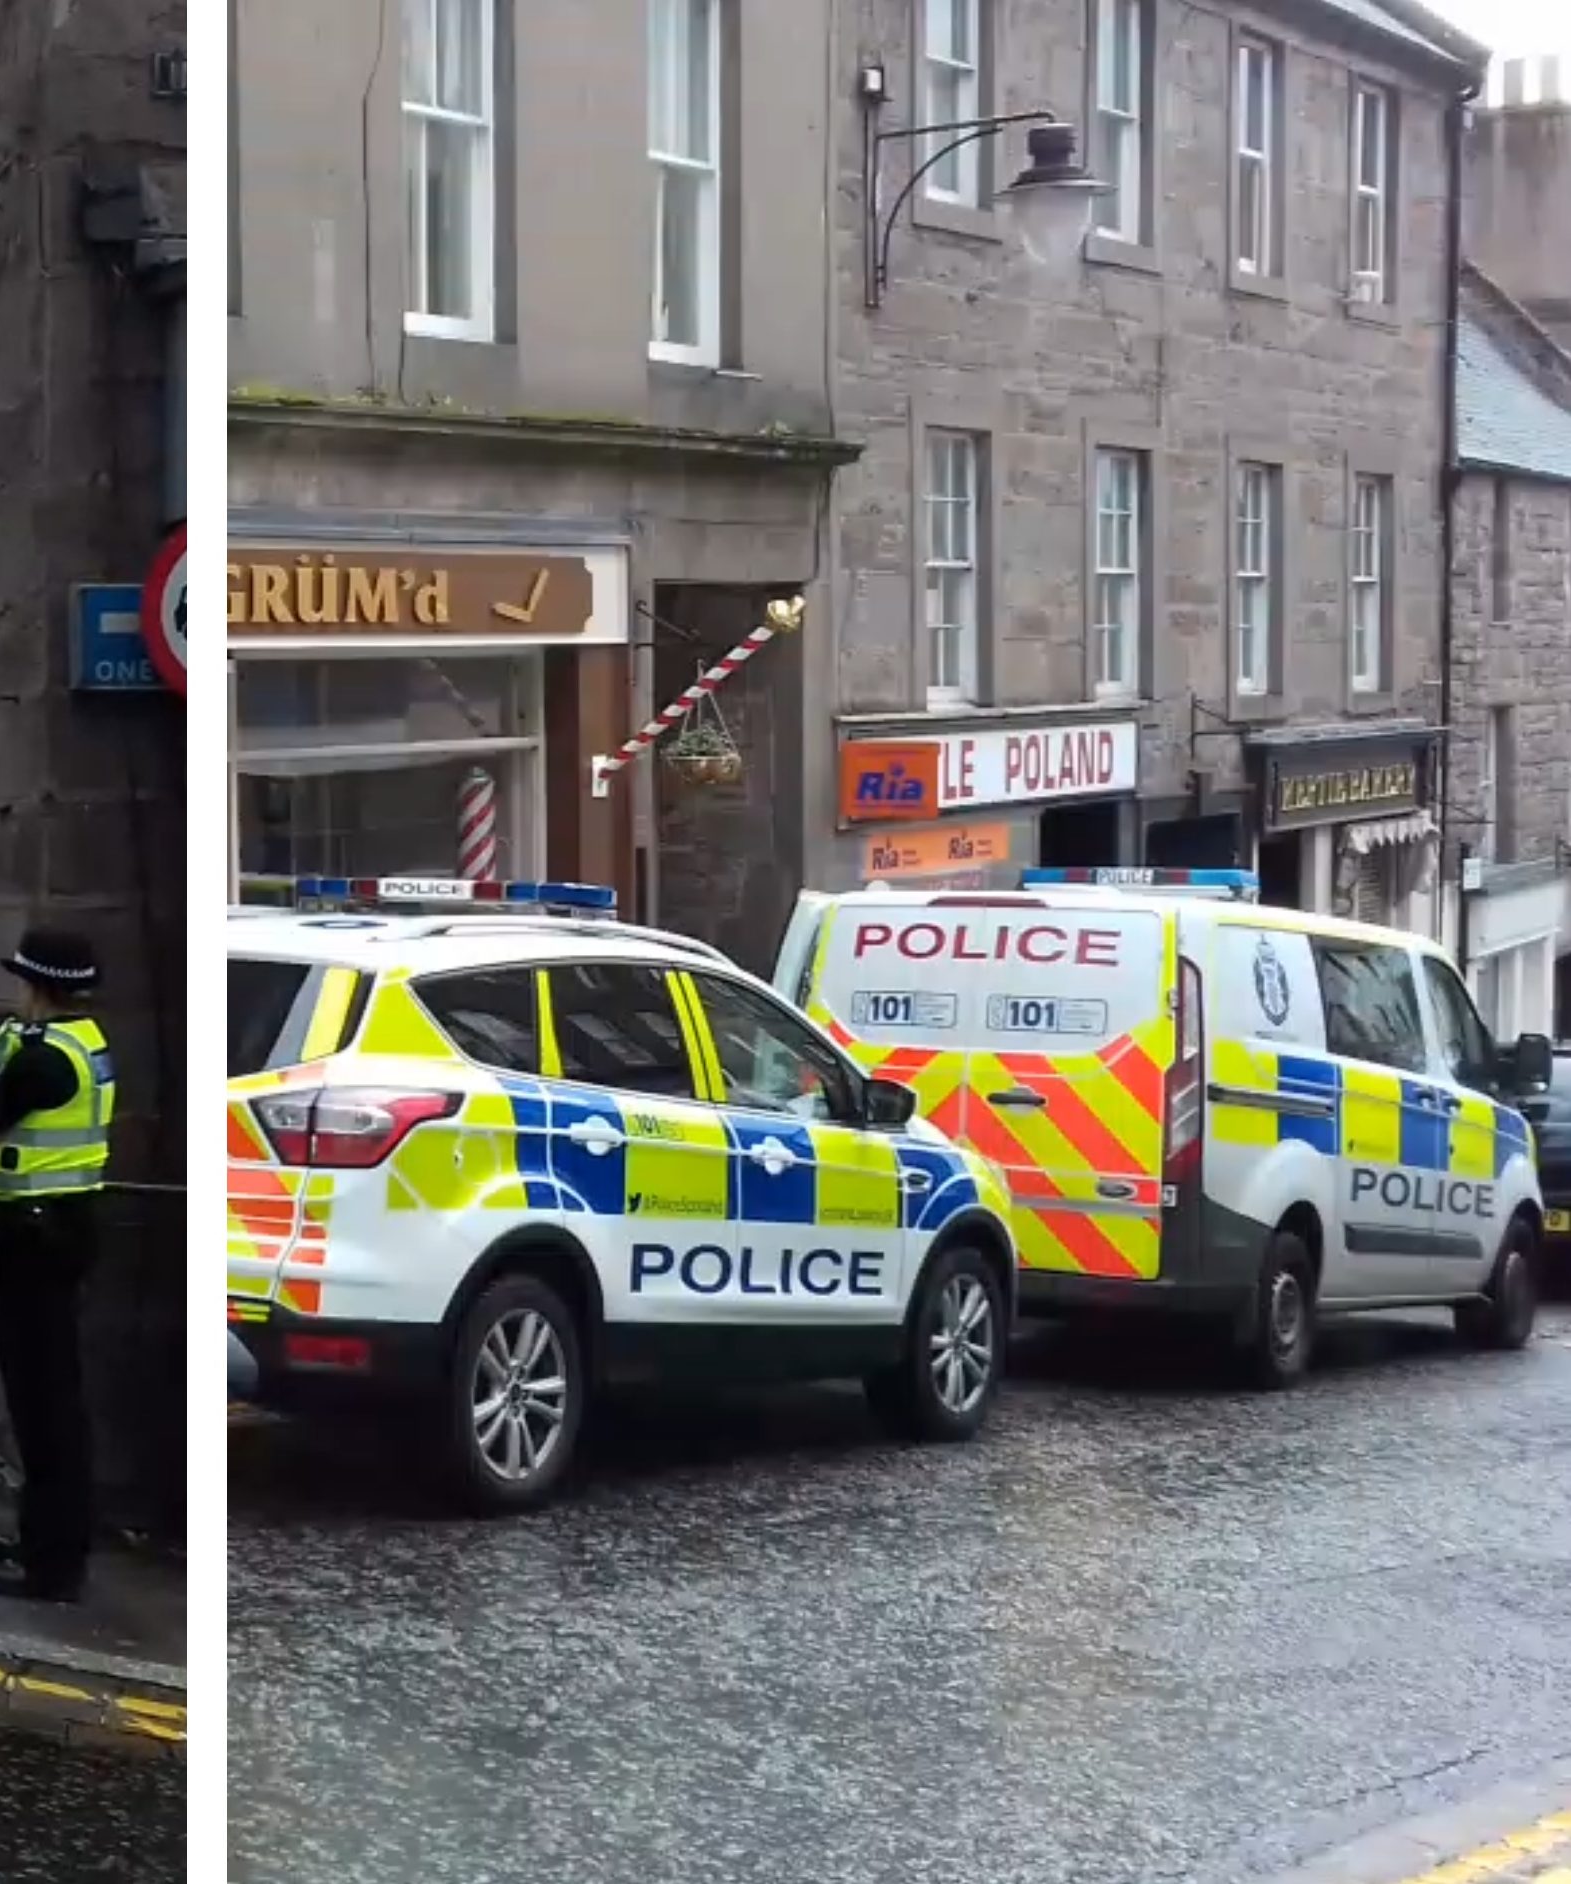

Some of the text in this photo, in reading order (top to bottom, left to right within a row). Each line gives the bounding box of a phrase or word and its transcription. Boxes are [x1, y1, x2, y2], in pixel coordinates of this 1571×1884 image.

[95, 661, 153, 682] ONE
[856, 760, 925, 805] Ria
[938, 731, 1114, 799] LE POLAND
[384, 882, 464, 896] POLICE
[1098, 869, 1152, 884] POLICE
[854, 923, 1122, 967] POLICE
[871, 995, 913, 1022] 101
[1009, 1000, 1056, 1027] 101
[1351, 1168, 1494, 1218] POLICE
[631, 1243, 886, 1297] POLICE
